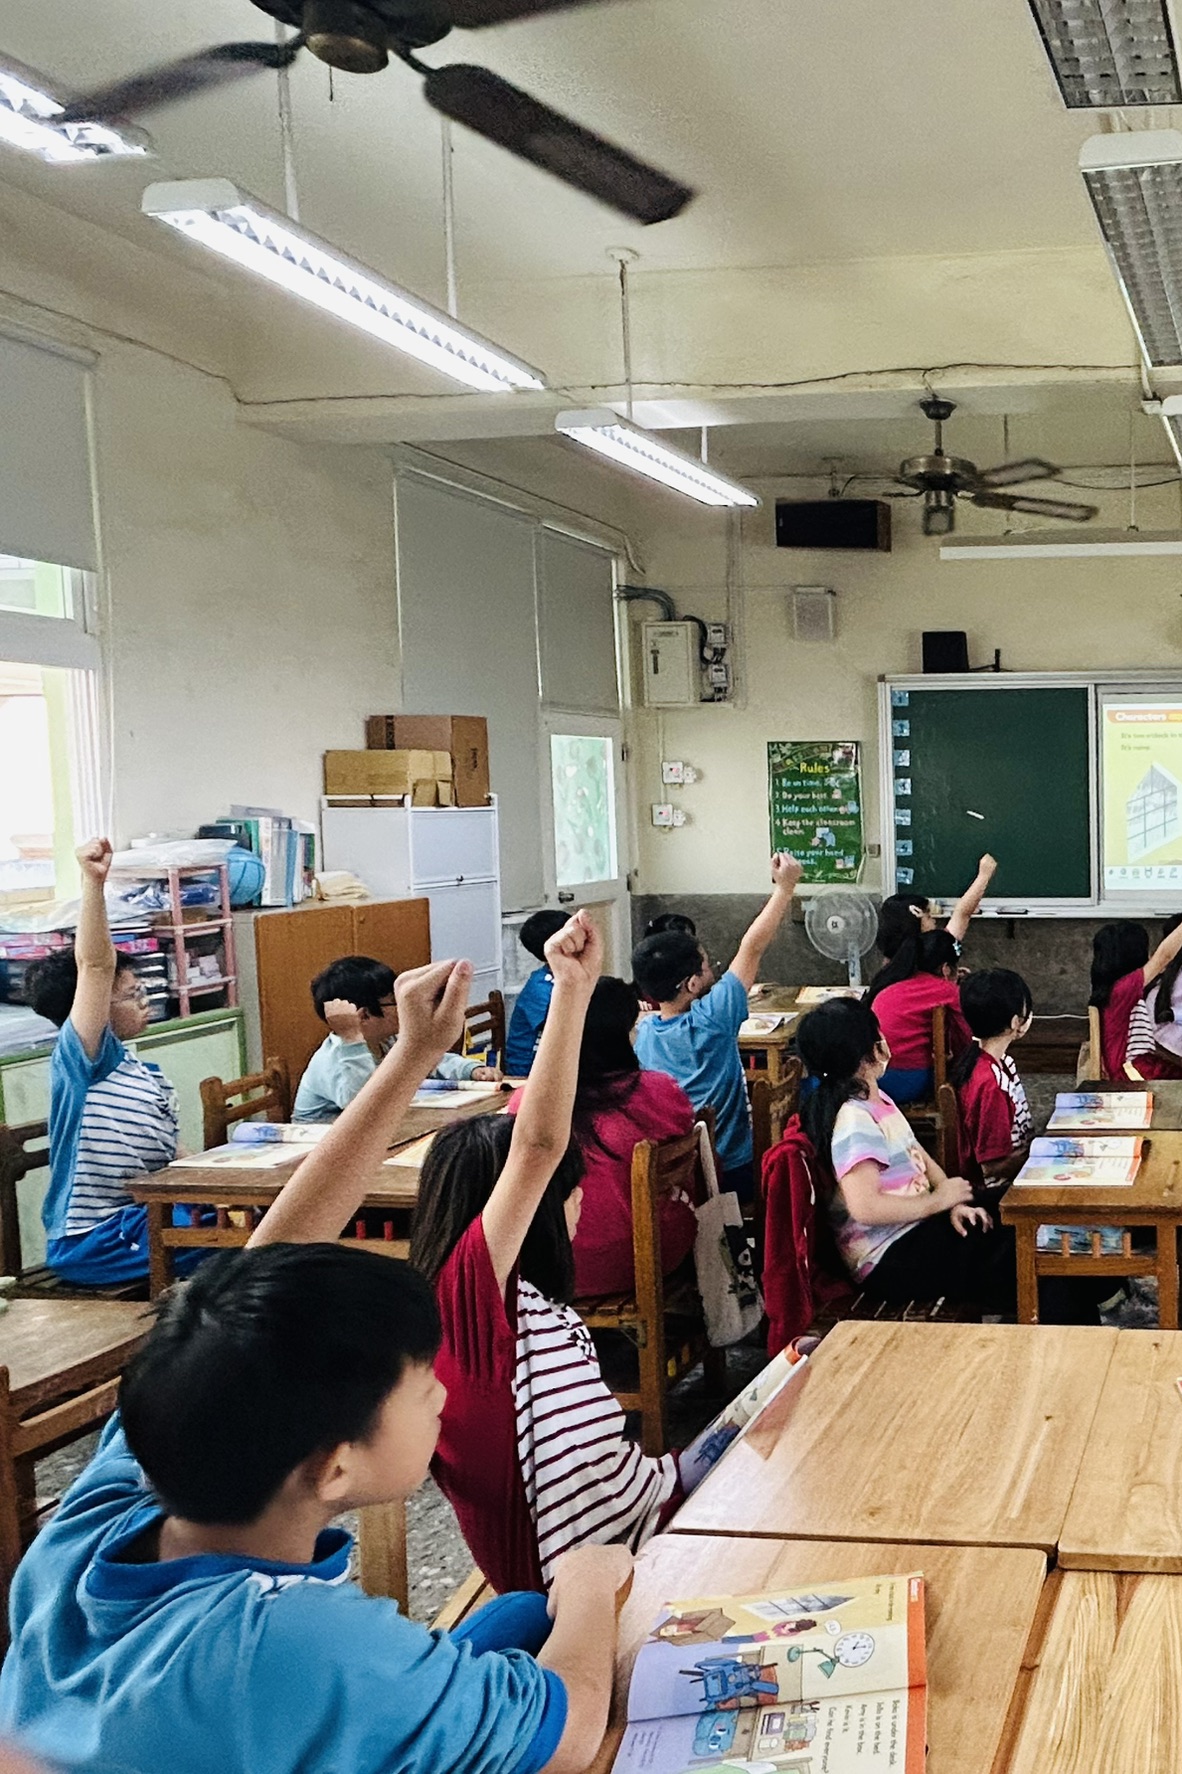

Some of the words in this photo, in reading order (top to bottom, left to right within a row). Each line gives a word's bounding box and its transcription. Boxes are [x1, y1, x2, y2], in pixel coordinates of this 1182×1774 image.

[800, 762, 830, 774] Rules
[781, 804, 799, 814] Help
[801, 805, 817, 813] each
[782, 818, 800, 829] Keep
[801, 818, 814, 827] the
[828, 1707, 837, 1718] Can
[825, 1728, 834, 1740] find
